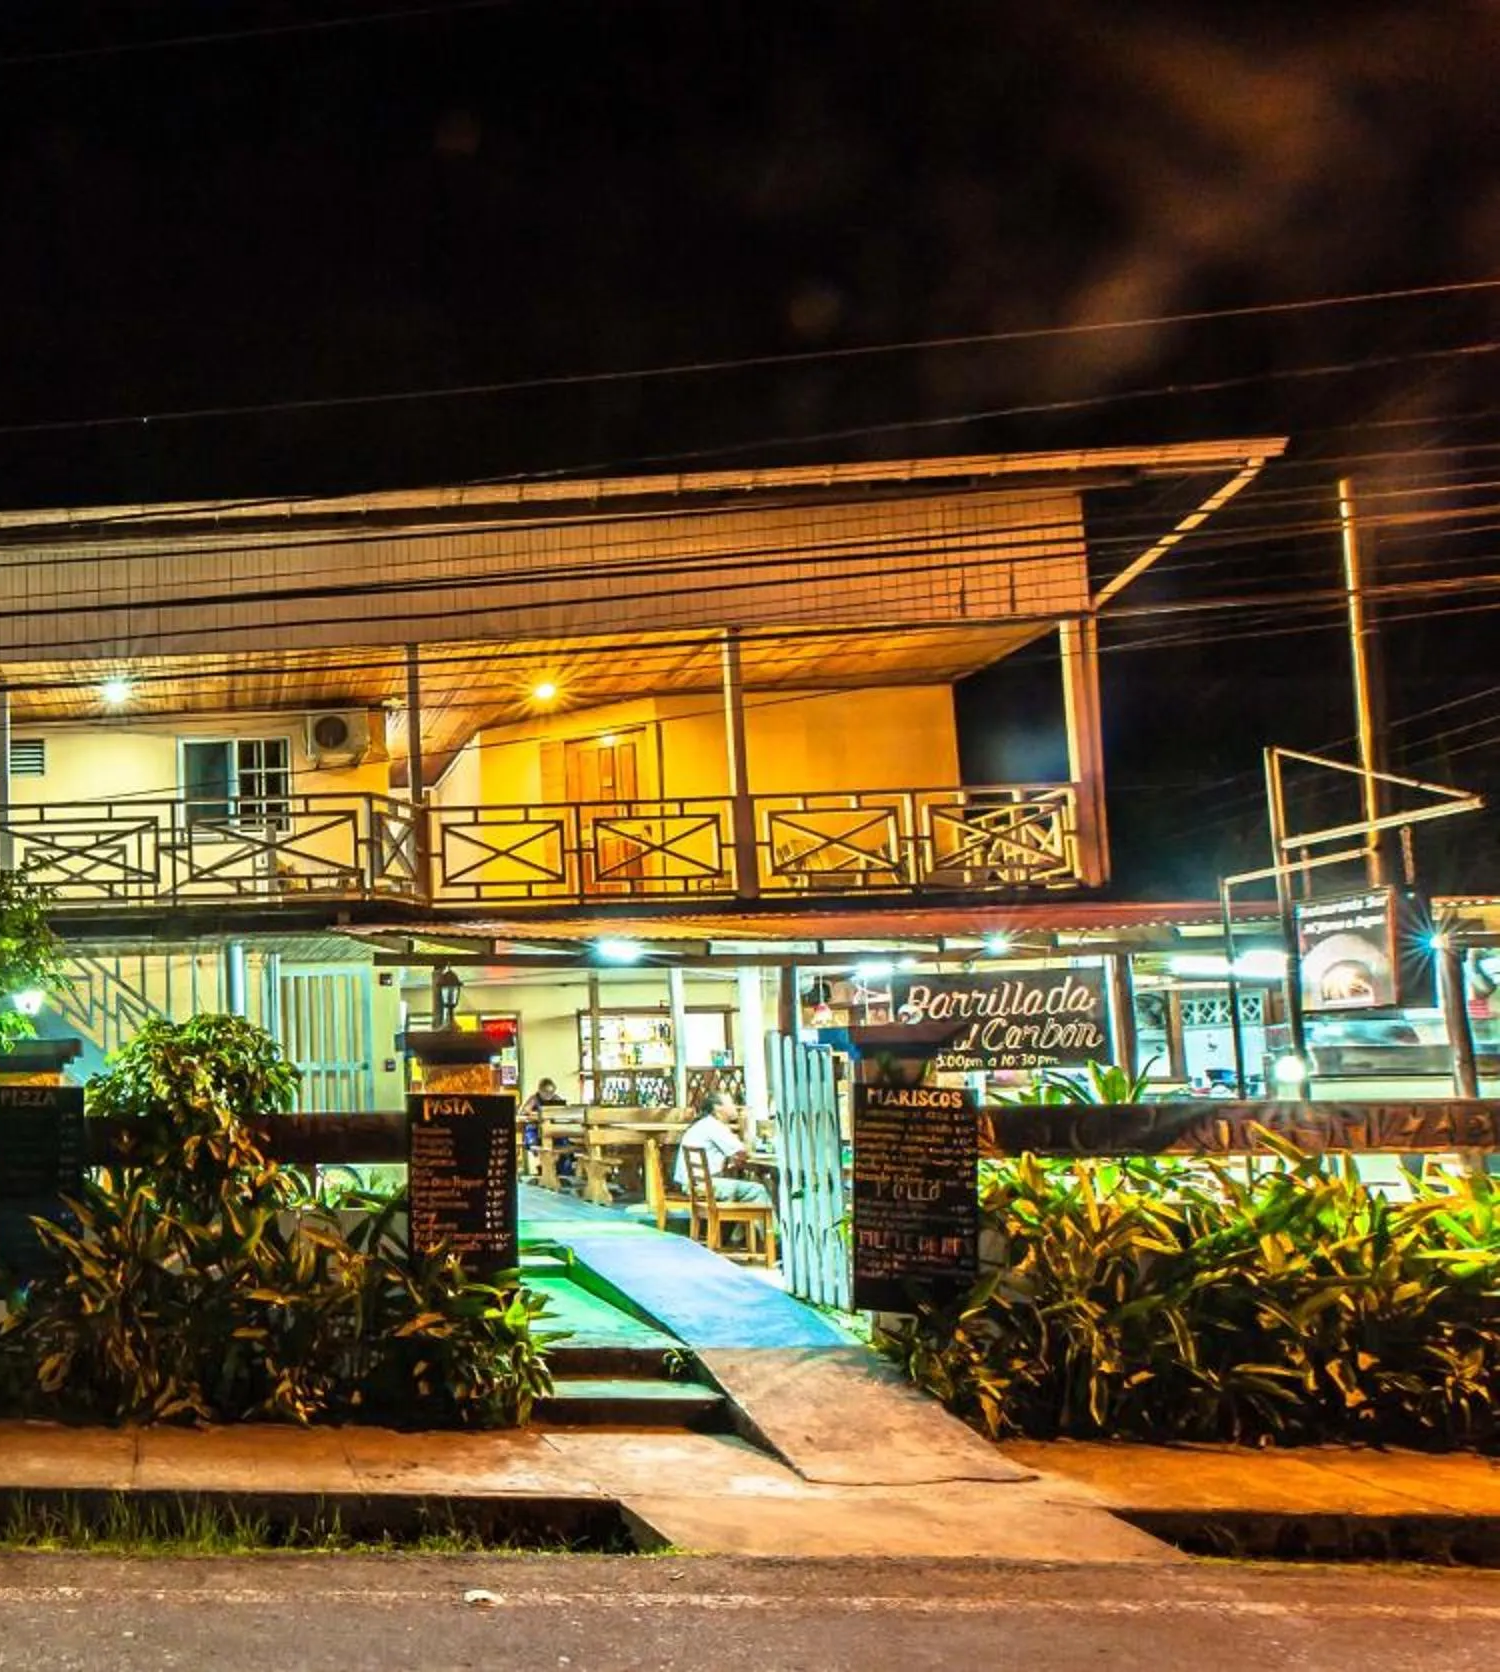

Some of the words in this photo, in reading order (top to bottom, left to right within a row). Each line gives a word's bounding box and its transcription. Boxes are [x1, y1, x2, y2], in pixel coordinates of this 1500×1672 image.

[987, 1056, 997, 1067] a
[0, 1088, 57, 1107] PIZZA
[866, 1087, 964, 1109] MARISCOS
[423, 1097, 475, 1121] PASTA
